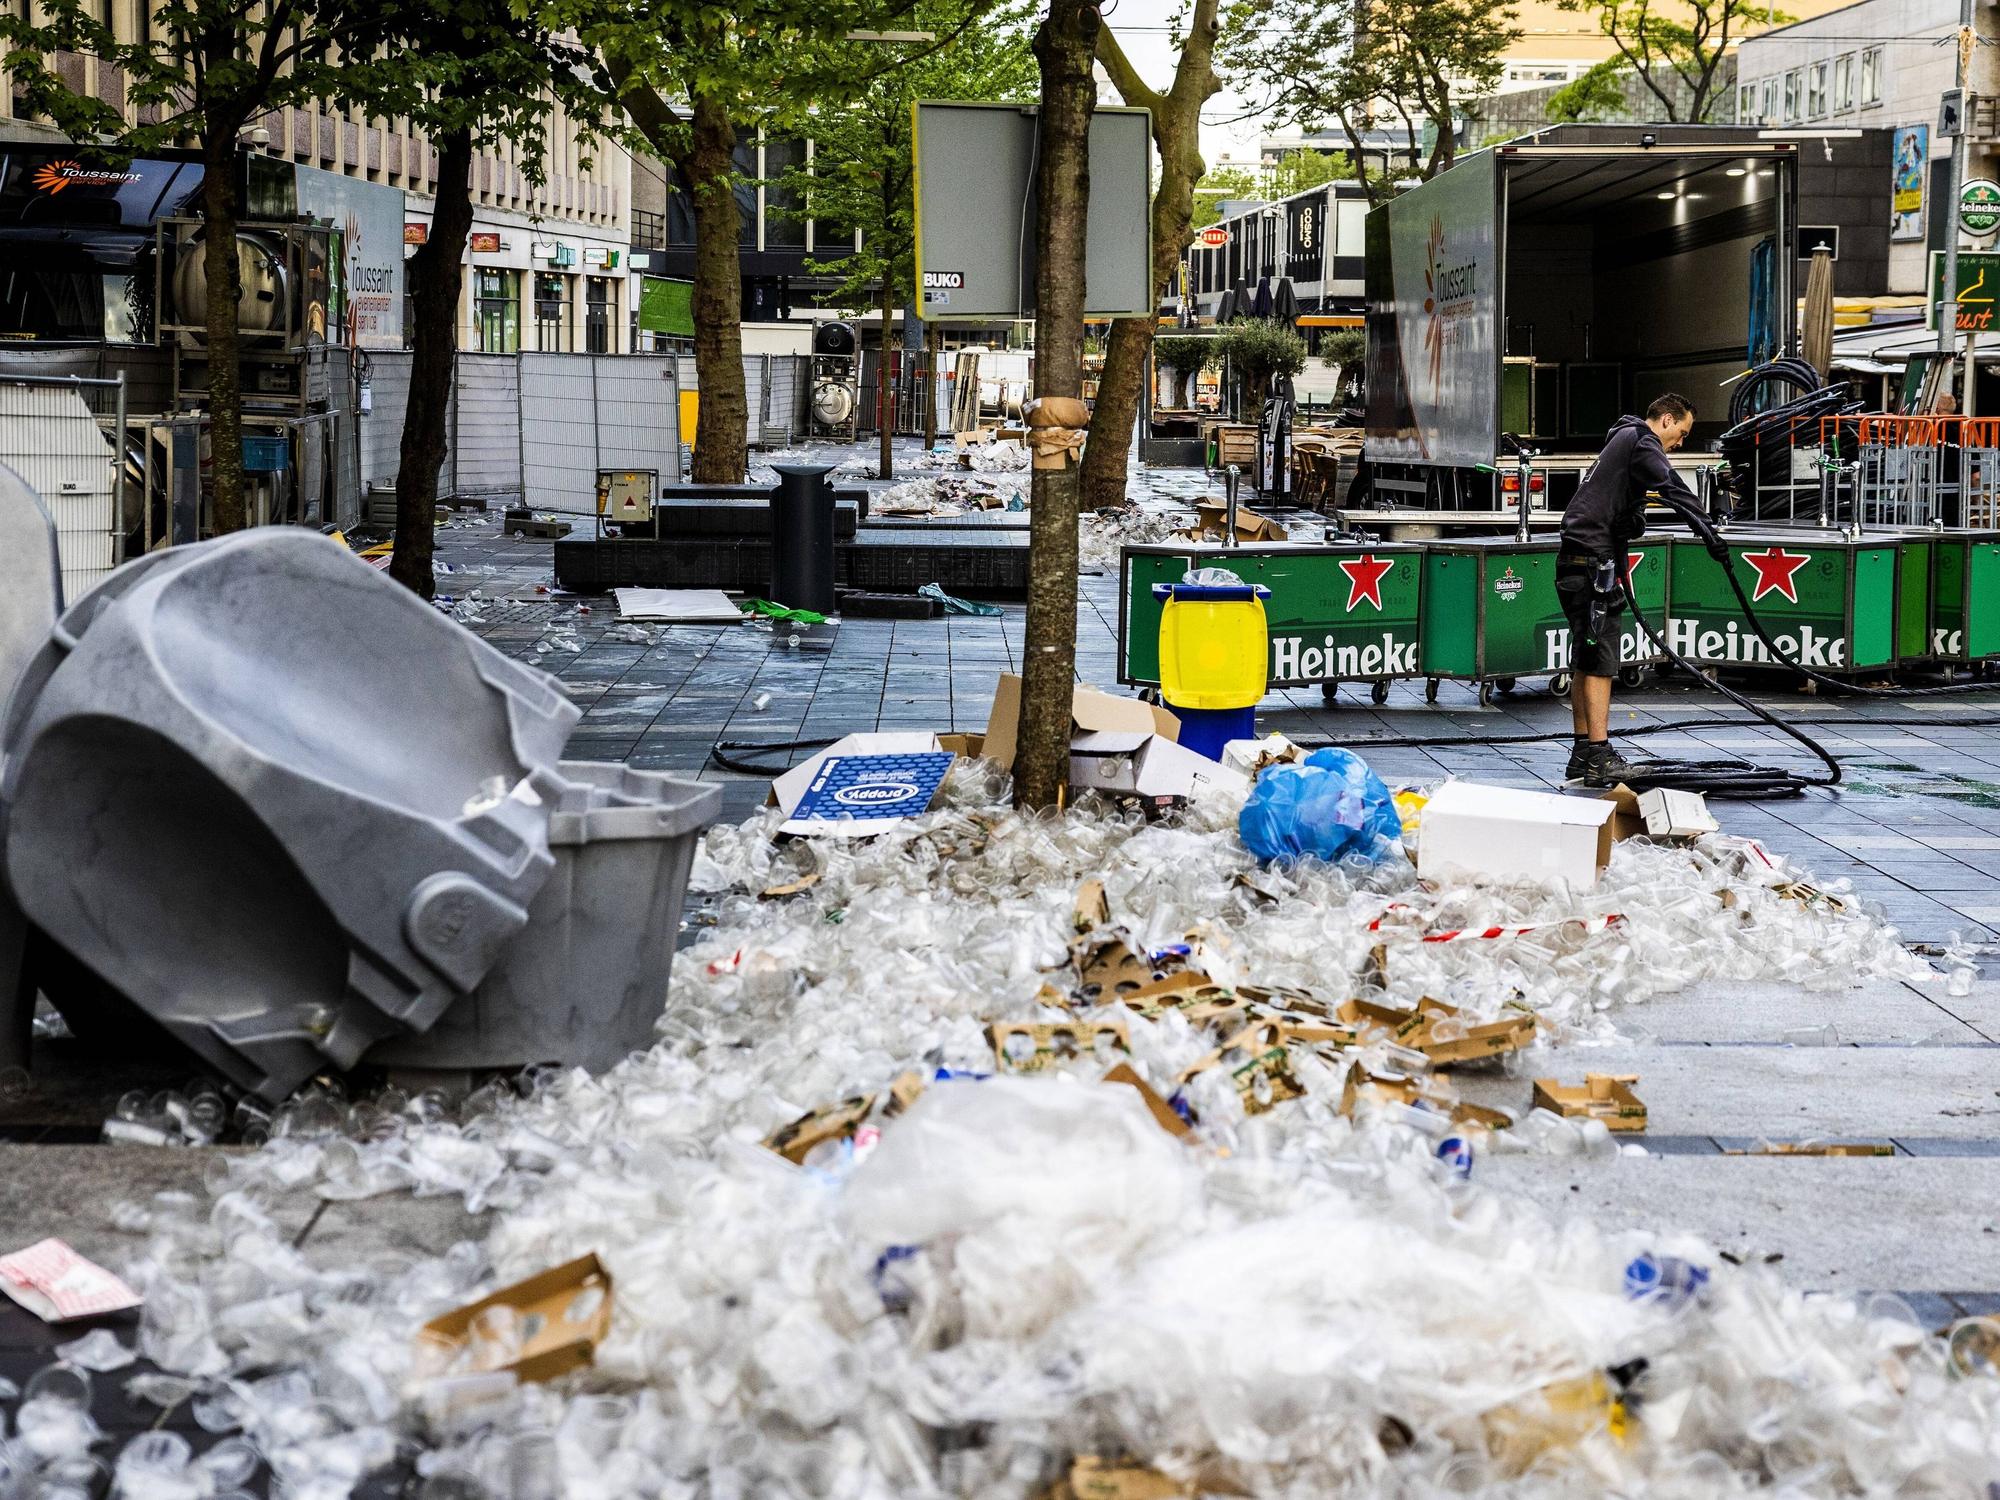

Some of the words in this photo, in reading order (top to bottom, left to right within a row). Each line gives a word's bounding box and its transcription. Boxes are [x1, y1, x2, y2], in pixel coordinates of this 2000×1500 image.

[62, 167, 143, 181] Toussaint
[1303, 207, 1313, 249] COSMO
[351, 256, 393, 294] Toussaint
[924, 273, 961, 288] BUKO
[1436, 256, 1477, 303] Toussaint
